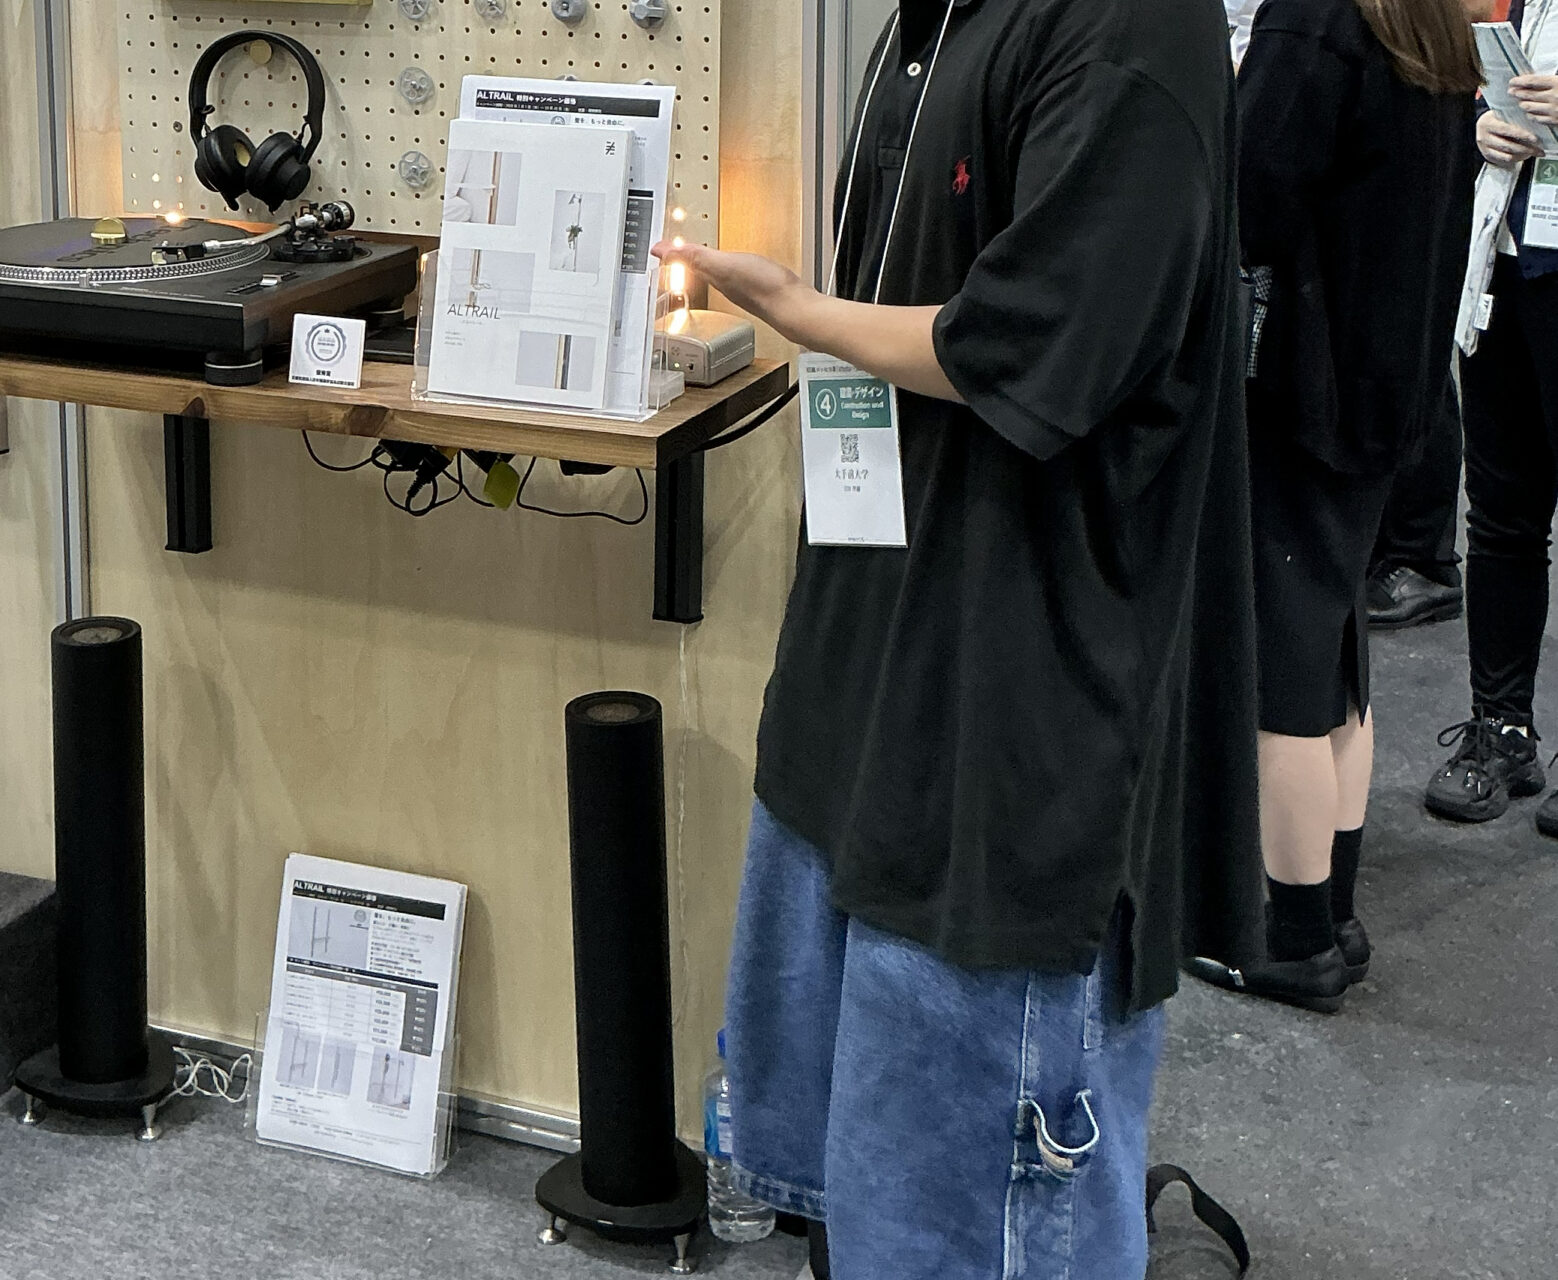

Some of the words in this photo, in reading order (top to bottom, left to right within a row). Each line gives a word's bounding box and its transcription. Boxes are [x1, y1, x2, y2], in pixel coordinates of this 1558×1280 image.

[477, 90, 515, 102] ALTRAIL
[446, 302, 501, 320] ALTRAIL
[294, 880, 325, 893] ALTRAIL
